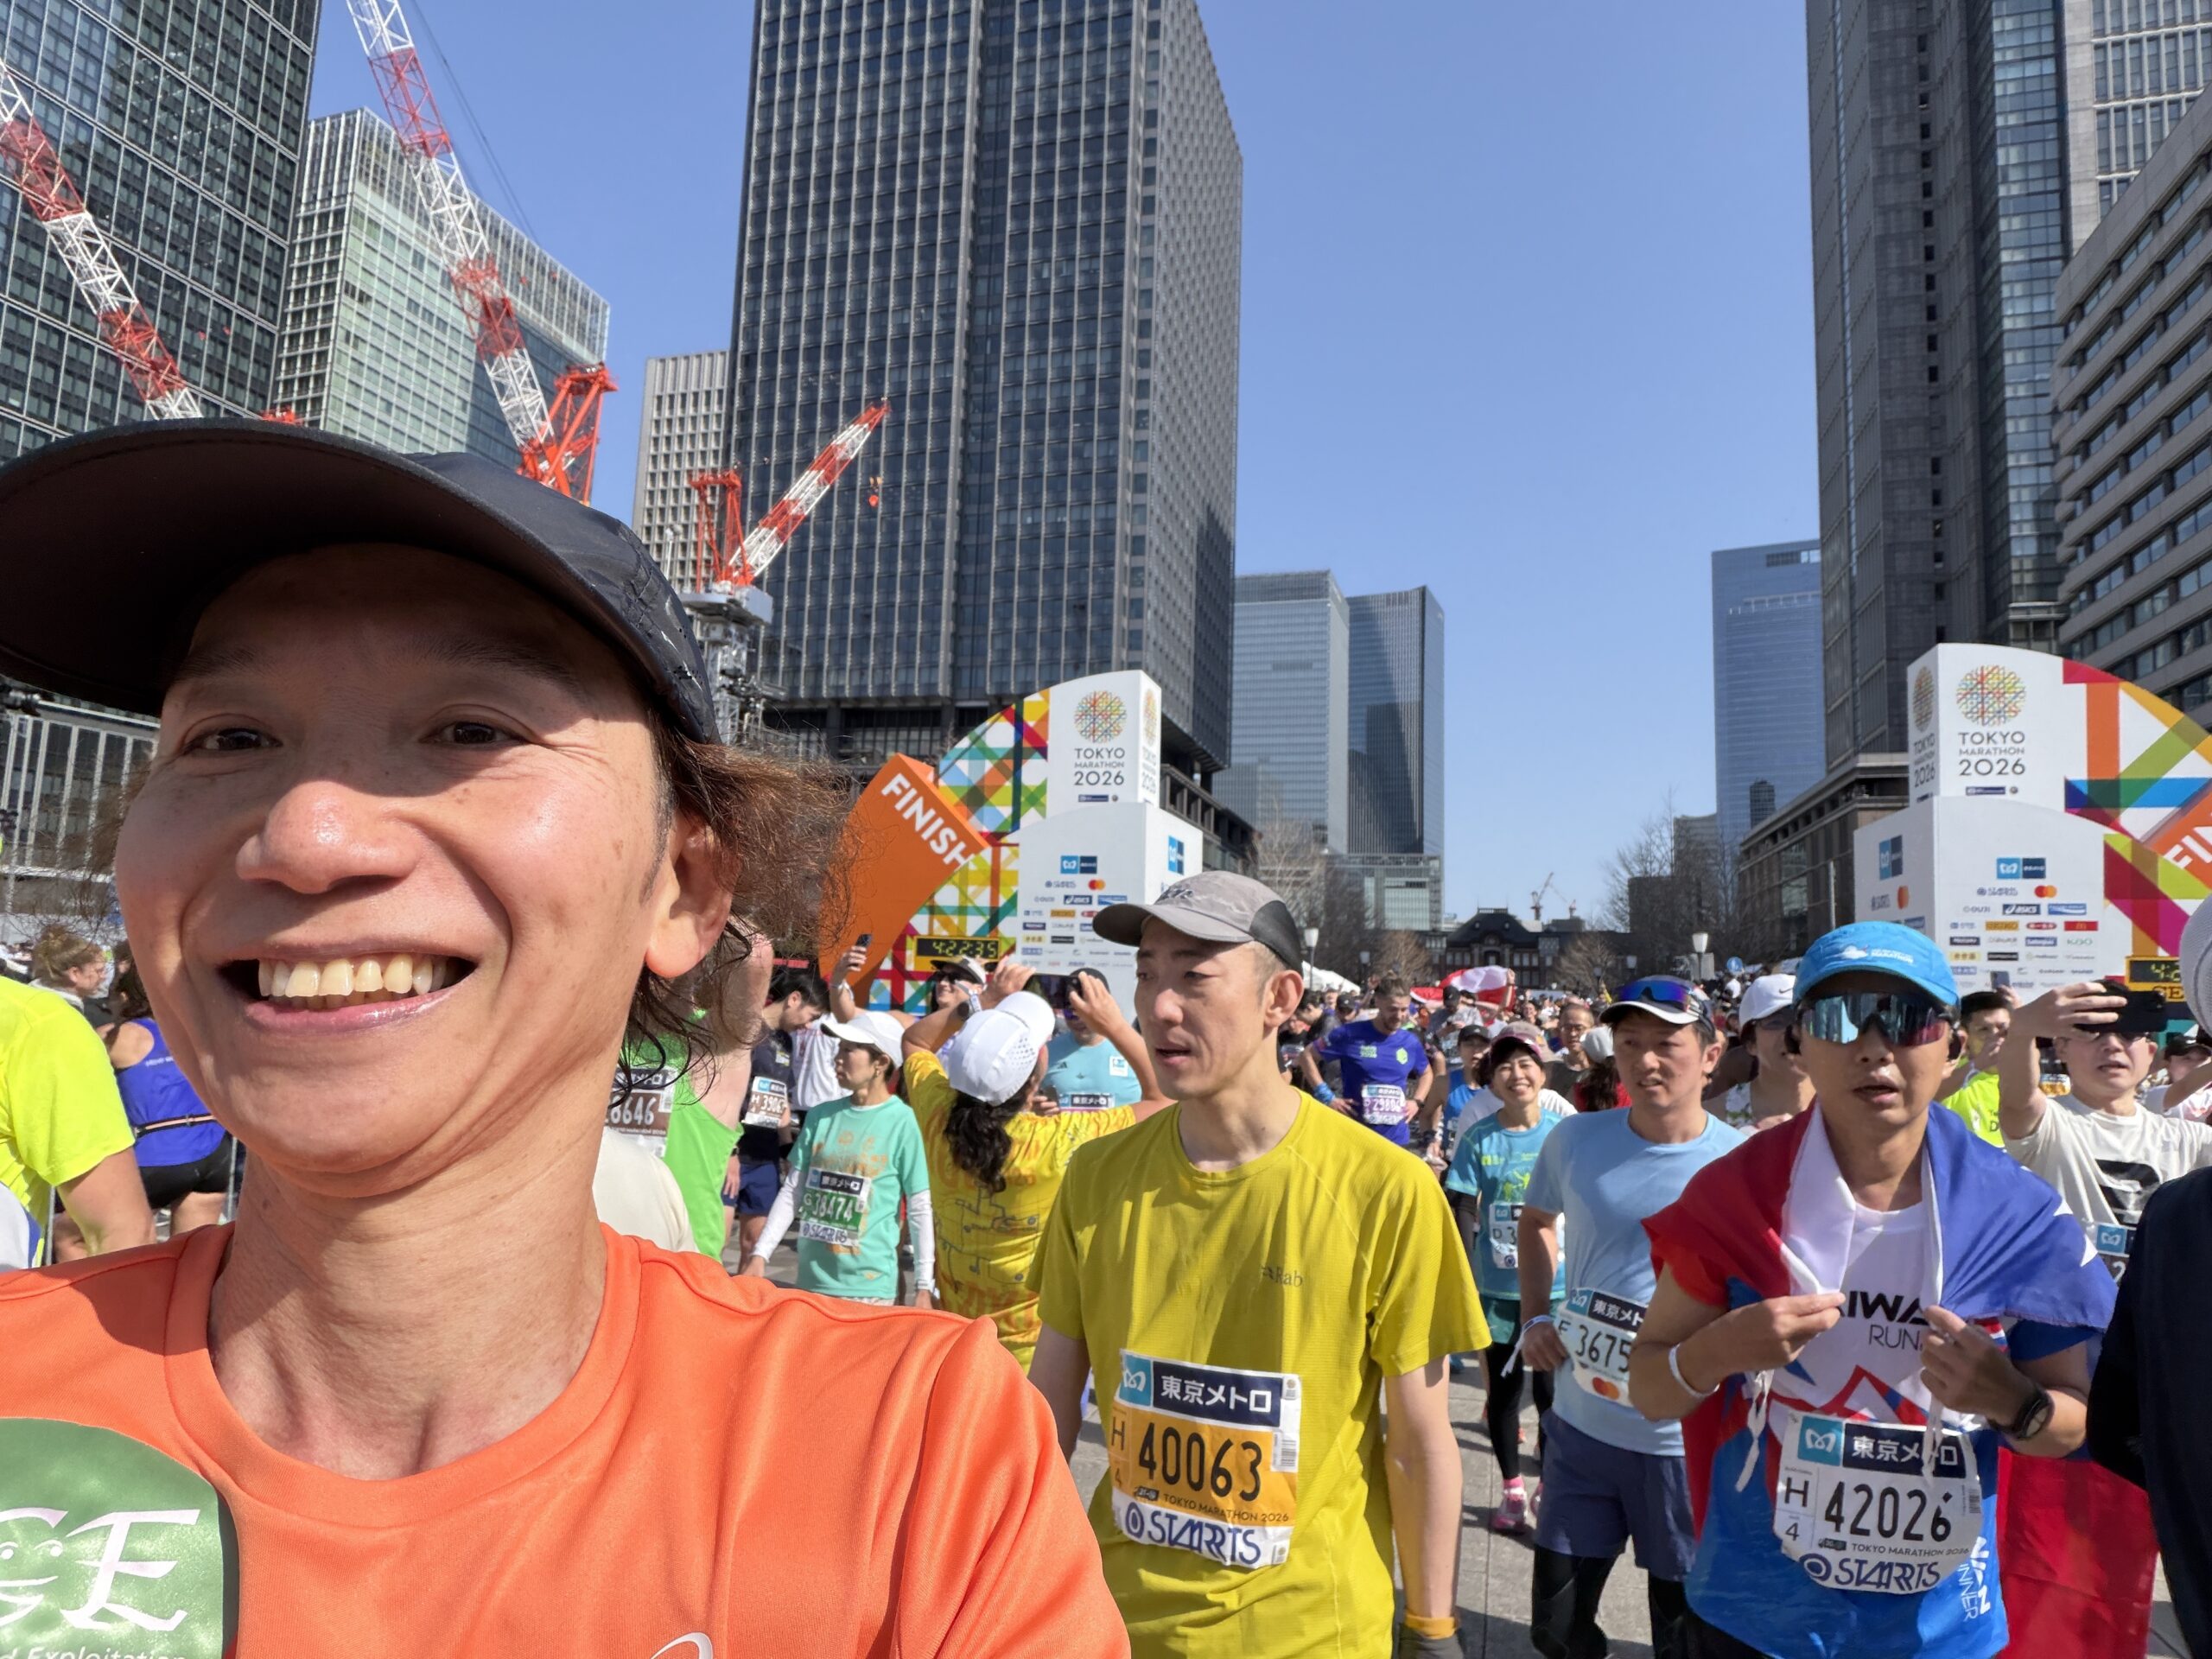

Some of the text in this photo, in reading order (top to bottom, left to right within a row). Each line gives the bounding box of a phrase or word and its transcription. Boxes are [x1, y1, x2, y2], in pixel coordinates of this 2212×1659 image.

[1958, 731, 2025, 745] TOKYO
[1074, 747, 1125, 759] TOKYO
[1959, 747, 2024, 756] MARATHON
[1074, 770, 1124, 785] 2026
[1914, 761, 1936, 787] 2026
[1959, 758, 2025, 776] 2026
[881, 772, 977, 870] FINISH
[932, 941, 997, 958] 4:22:35
[606, 1096, 657, 1126] 8646
[1276, 1267, 1303, 1287] Rab
[1160, 1375, 1272, 1413] 東京メトロ
[1111, 1417, 1126, 1451] H
[1139, 1422, 1262, 1502] 40063
[1852, 1435, 1958, 1465] 東京メロ
[1784, 1477, 1809, 1507] H
[1164, 1493, 1196, 1510] TOKYO
[1198, 1504, 1258, 1522] MARATHON
[1261, 1513, 1289, 1522] 2026
[1825, 1481, 1953, 1542] 42026
[1785, 1522, 1800, 1541] 4
[1852, 1542, 1885, 1554] TOKYO
[1889, 1548, 1943, 1556] MARATHON
